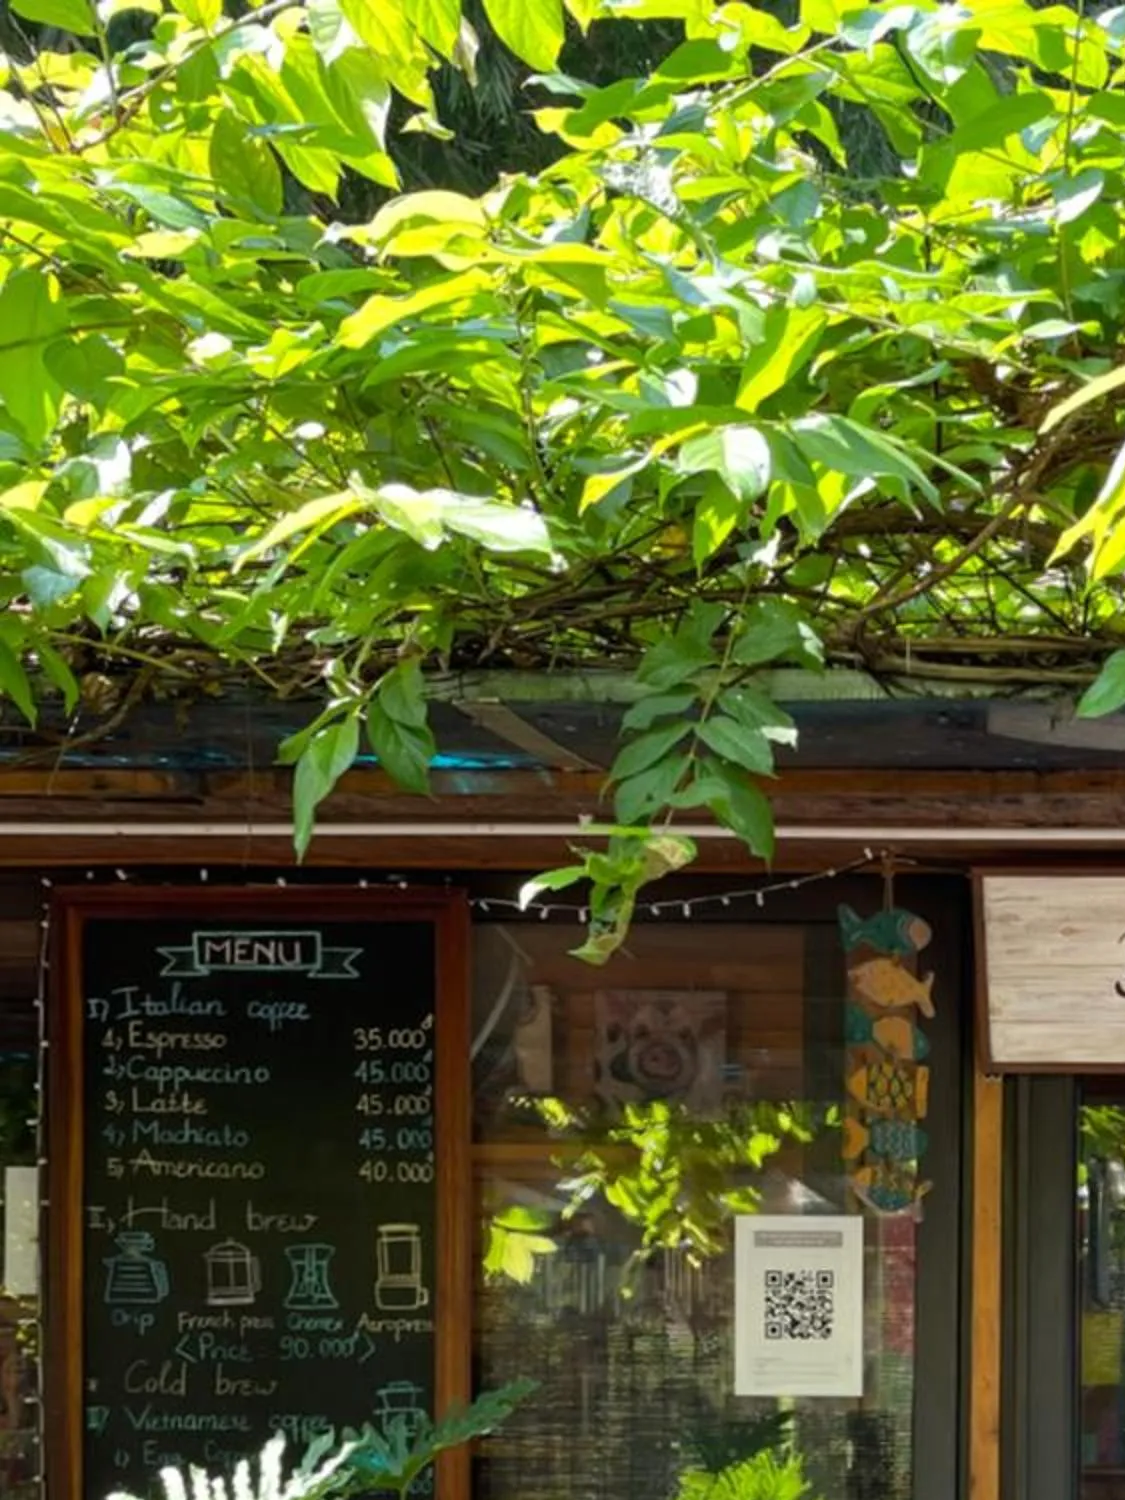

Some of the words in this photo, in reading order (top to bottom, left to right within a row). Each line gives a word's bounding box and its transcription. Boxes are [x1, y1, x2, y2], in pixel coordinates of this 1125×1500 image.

[203, 938, 302, 966] MENU
[111, 980, 227, 1019] Italian
[128, 1020, 228, 1060] Espresso
[125, 1056, 271, 1093] Cappuccino
[131, 1086, 208, 1116] Latte
[129, 1148, 266, 1181] Americano
[121, 1196, 217, 1232] Hand
[246, 1199, 320, 1233] brew
[111, 1311, 156, 1334] Drip
[177, 1310, 236, 1334] French
[240, 1316, 276, 1339] press
[124, 1360, 188, 1396] Cold
[214, 1362, 279, 1397] brew
[121, 1405, 252, 1431] Vietnamese
